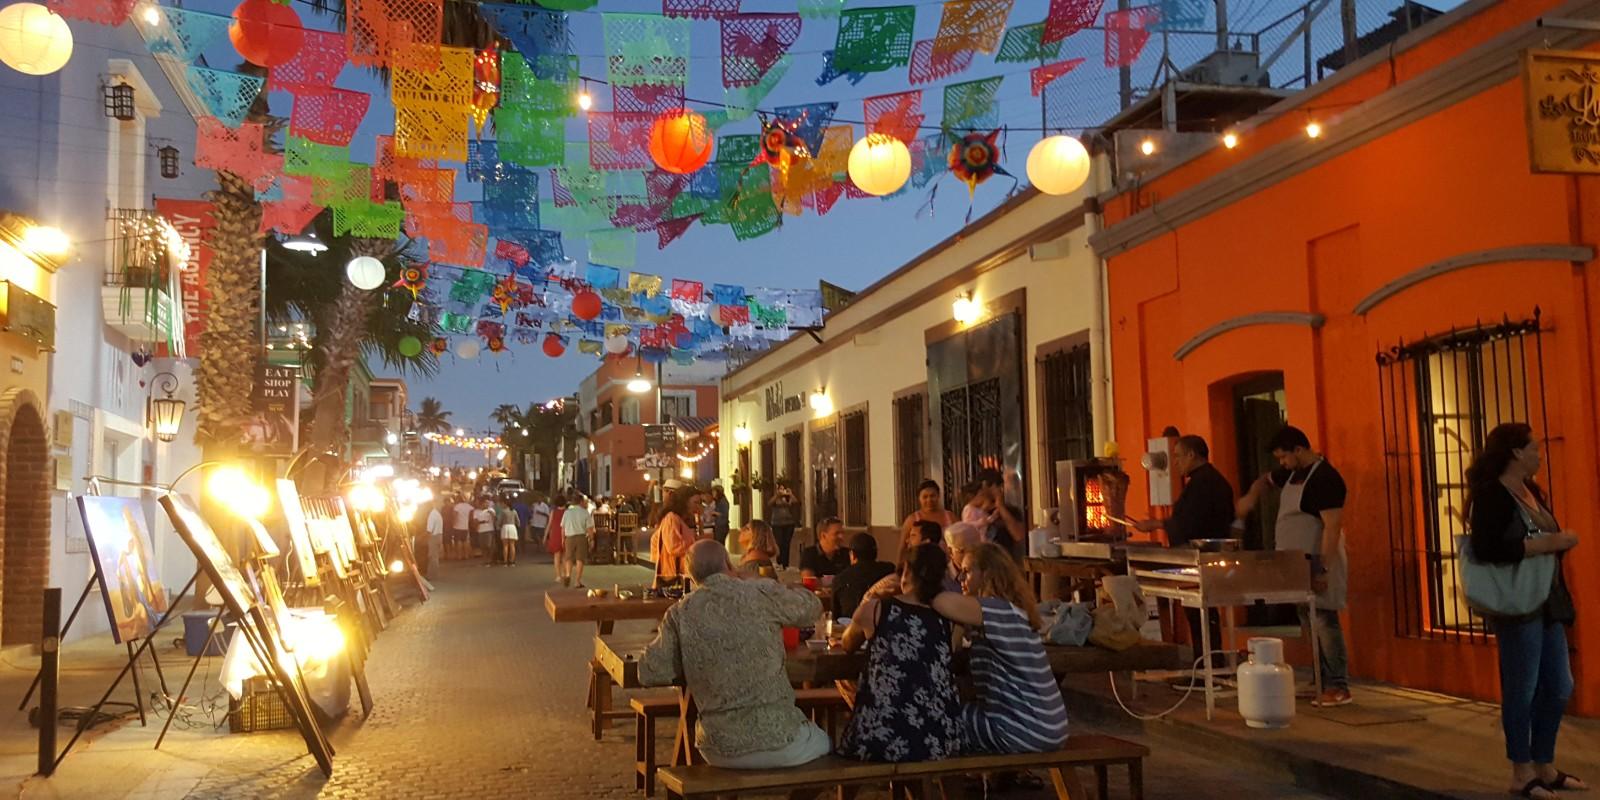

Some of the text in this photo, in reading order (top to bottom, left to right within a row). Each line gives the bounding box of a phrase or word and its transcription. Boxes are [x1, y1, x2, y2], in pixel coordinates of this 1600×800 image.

[265, 368, 291, 377] EAT
[264, 379, 292, 387] SHOP
[264, 389, 290, 397] PLAY
